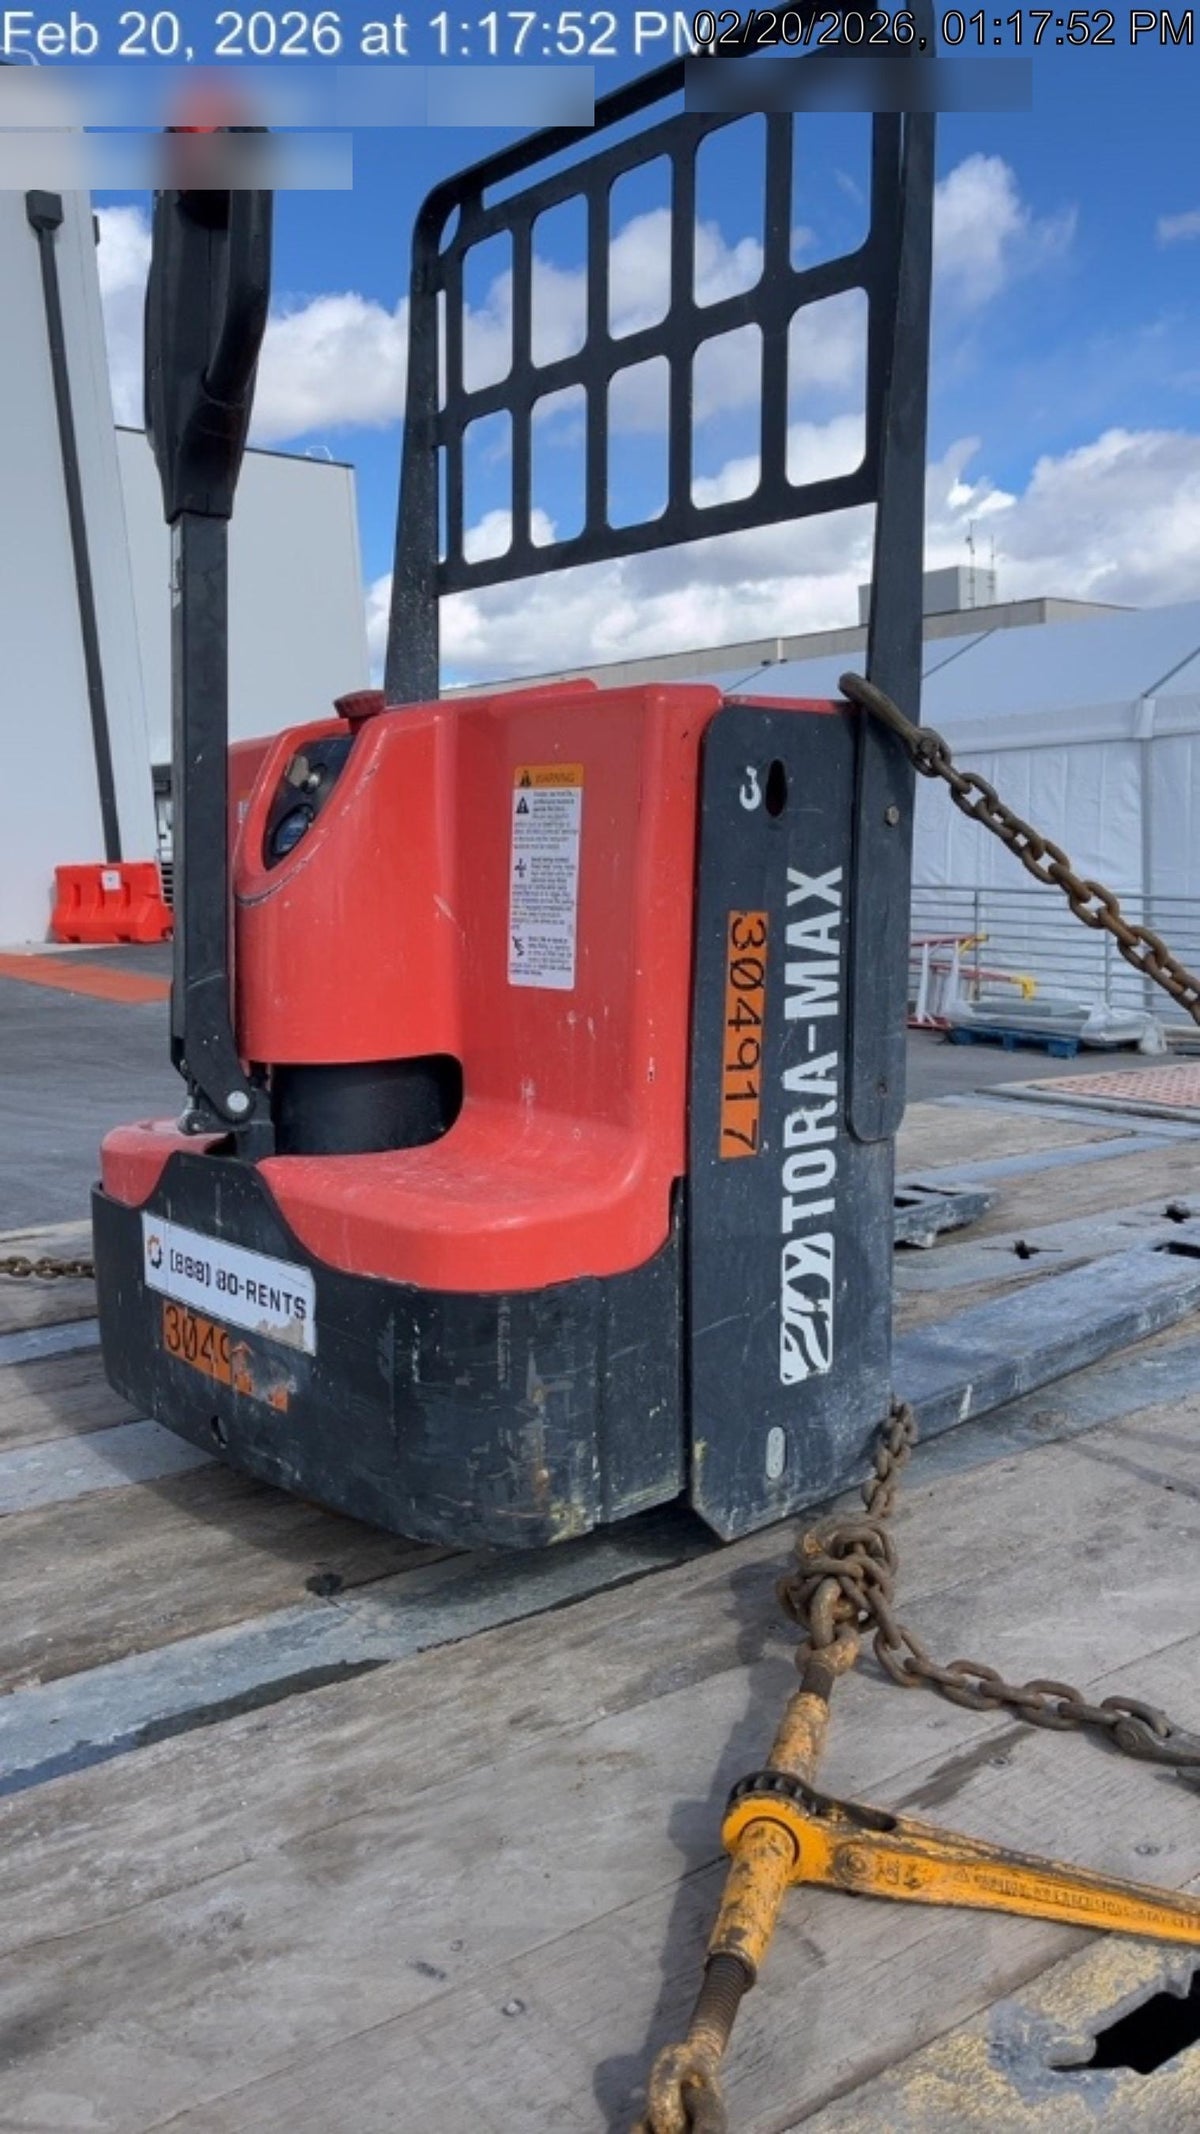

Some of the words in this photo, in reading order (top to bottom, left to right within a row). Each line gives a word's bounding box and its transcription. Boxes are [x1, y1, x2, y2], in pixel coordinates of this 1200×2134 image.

[725, 917, 767, 1151] 304917
[781, 866, 843, 1234] TORA-MAX
[170, 1248, 211, 1288] (888)
[215, 1268, 306, 1319] 80-RENTS
